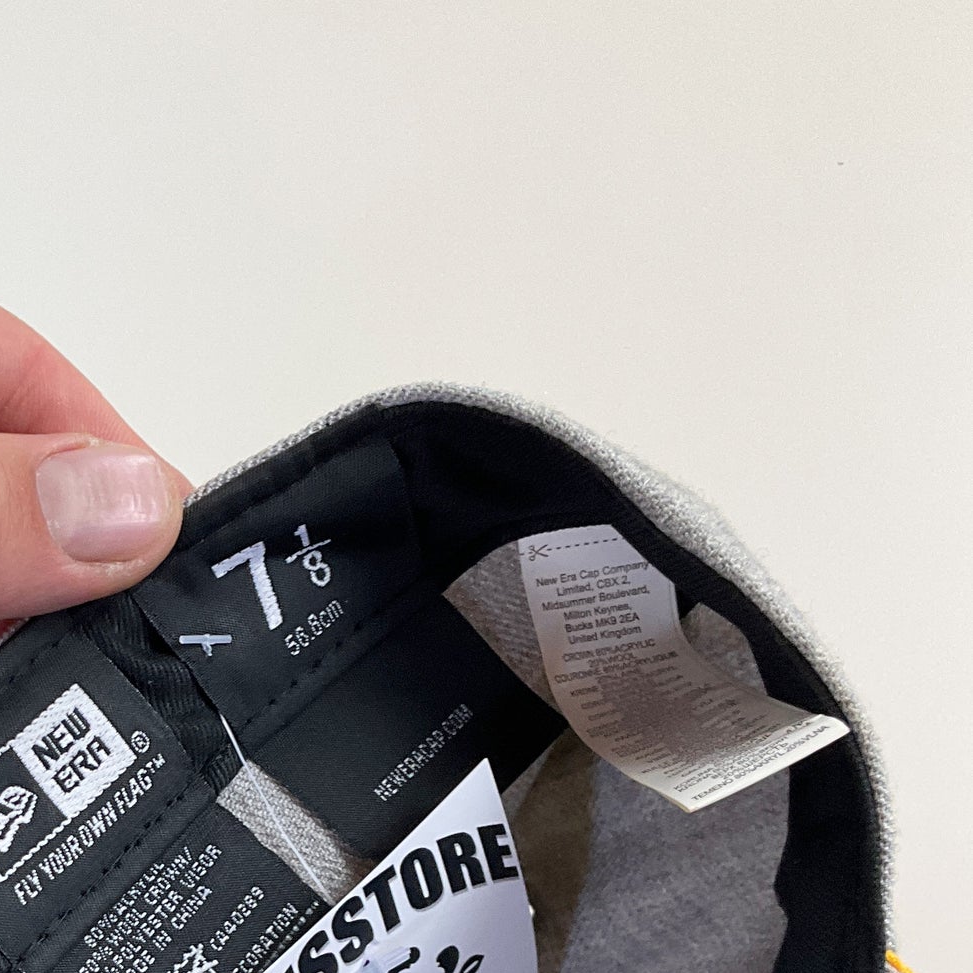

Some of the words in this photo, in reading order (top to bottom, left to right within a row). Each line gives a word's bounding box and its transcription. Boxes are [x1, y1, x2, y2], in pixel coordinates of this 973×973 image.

[211, 540, 283, 631] 7
[535, 577, 558, 587] New
[560, 572, 577, 583] Era
[579, 569, 600, 580] Cap
[602, 561, 649, 576] Company
[284, 600, 344, 657] 56.8cm
[541, 595, 596, 611] Midsummer
[563, 607, 592, 620] Milton
[564, 619, 594, 633] Bucks
[595, 615, 617, 628] MK9
[568, 630, 598, 645] United
[600, 626, 642, 639] Kingdom
[32, 706, 91, 771] NEW
[52, 735, 111, 794] ERA
[374, 703, 474, 802] NEWERACAP.COM
[13, 869, 43, 906] FLY
[39, 834, 85, 880] YOUR
[79, 800, 118, 848] OWN
[180, 845, 221, 887] VISOR
[153, 931, 171, 950] IN
[171, 886, 212, 929] CHINA
